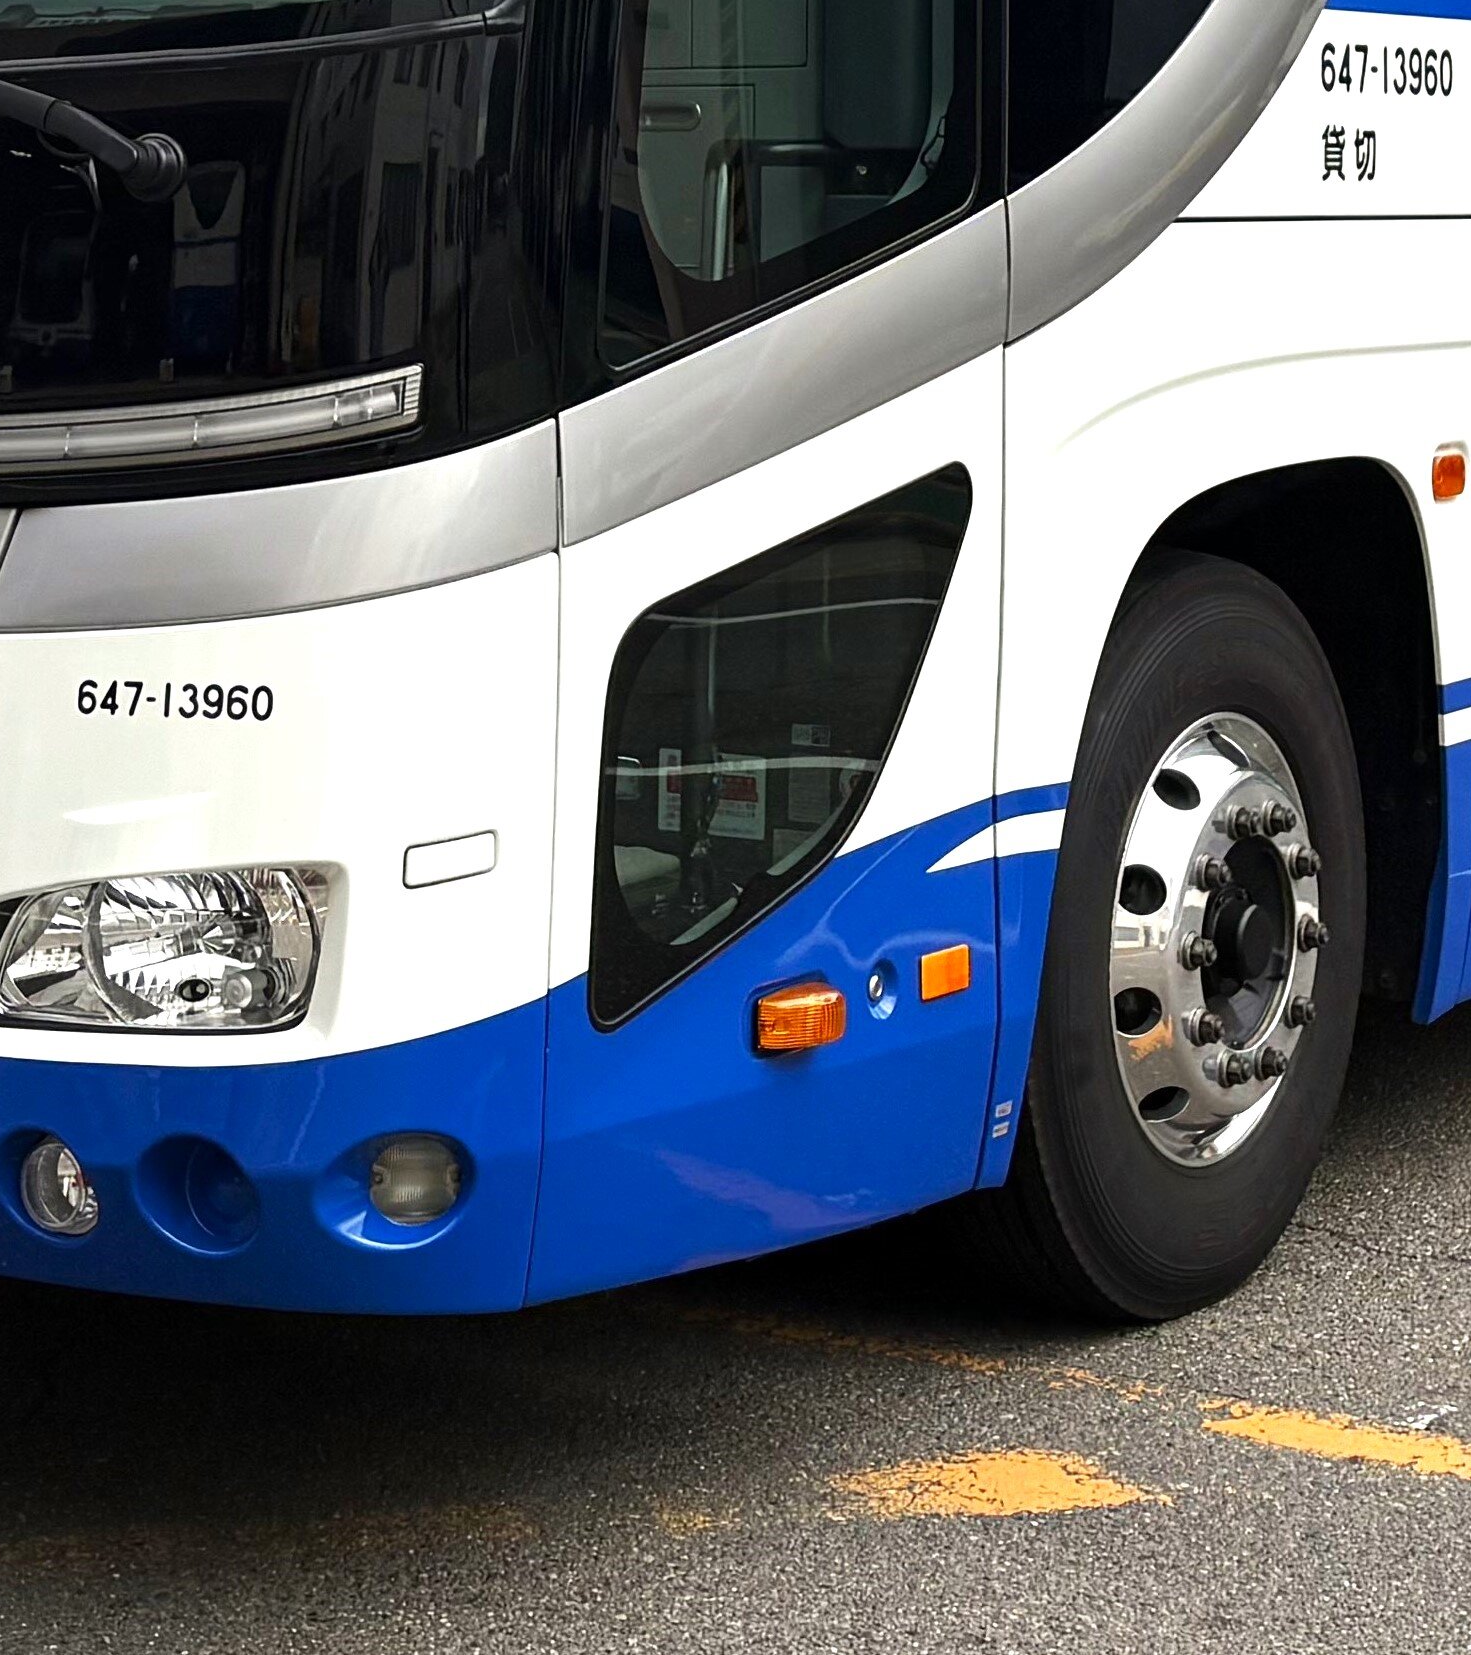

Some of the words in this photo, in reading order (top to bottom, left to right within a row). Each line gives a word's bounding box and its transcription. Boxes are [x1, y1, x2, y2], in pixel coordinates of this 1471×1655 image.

[1321, 42, 1454, 97] 647-13960
[1321, 124, 1377, 182] 貸切
[77, 679, 274, 722] 647-13960
